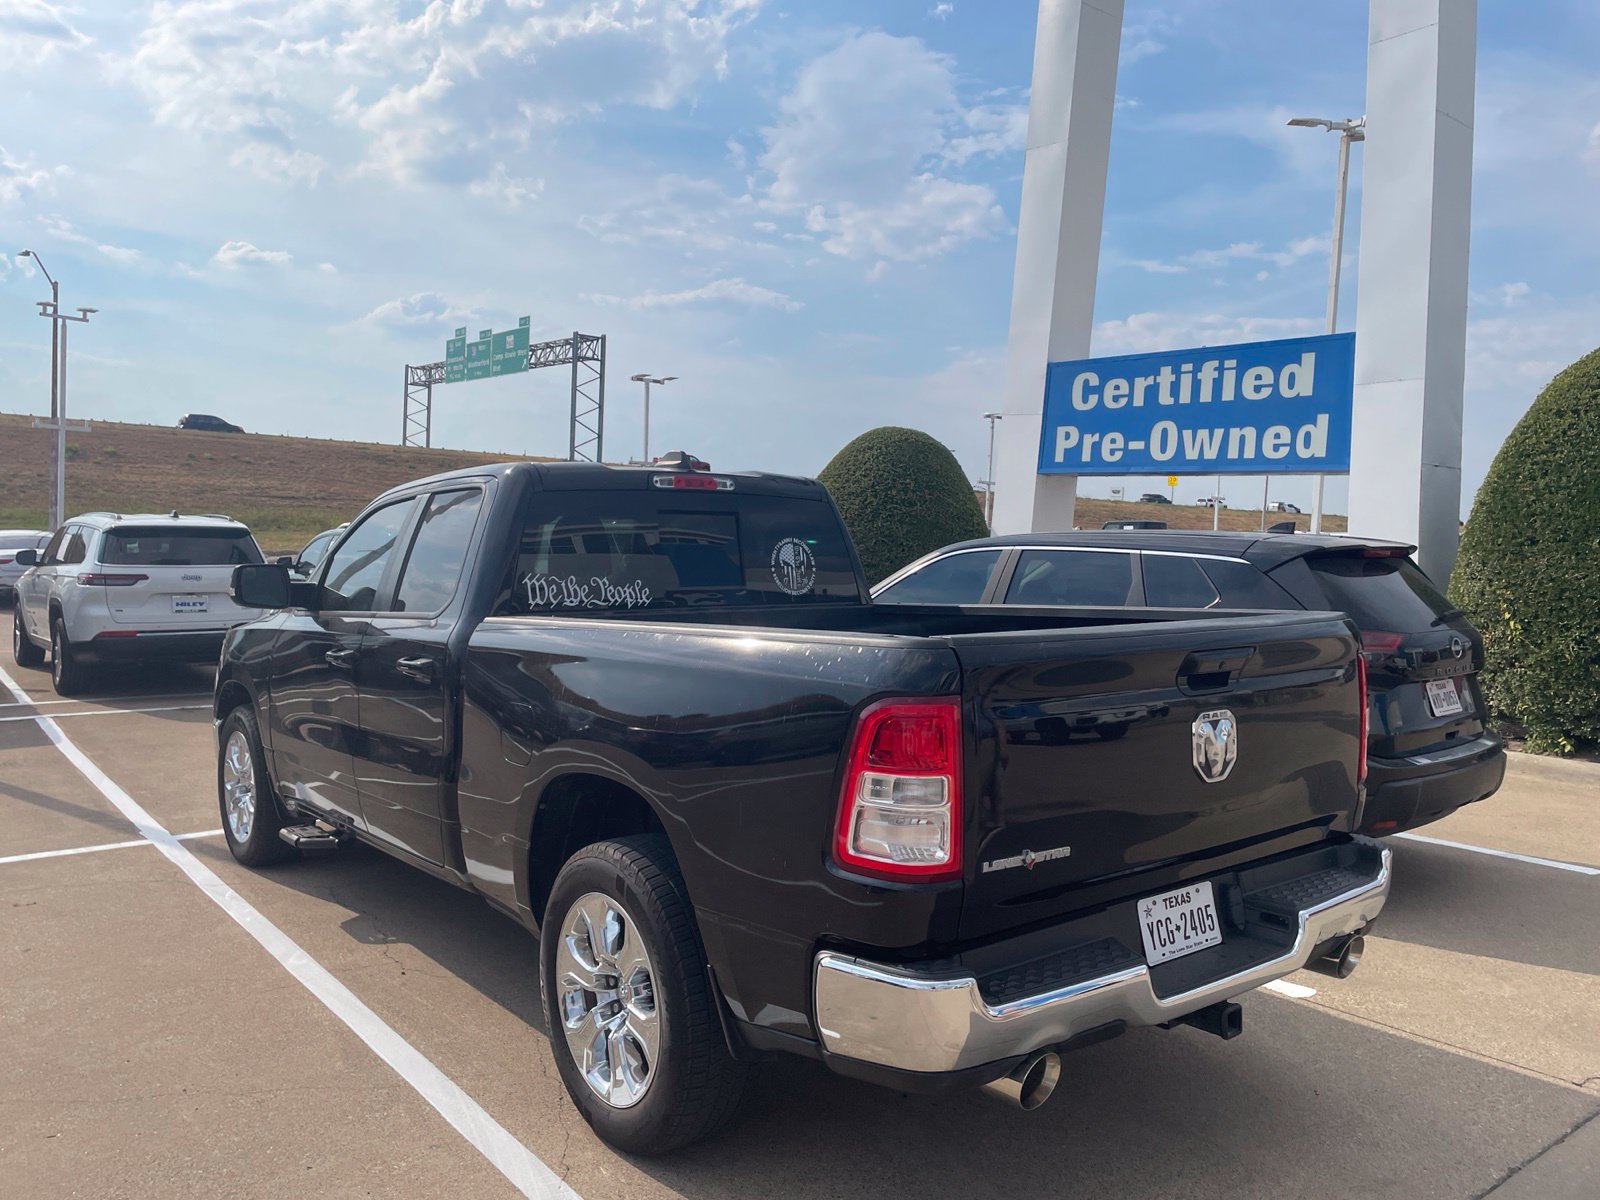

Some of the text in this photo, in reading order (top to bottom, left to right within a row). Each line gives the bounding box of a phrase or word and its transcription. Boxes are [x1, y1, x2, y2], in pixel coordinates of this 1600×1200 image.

[1071, 351, 1317, 411] Certified
[1054, 413, 1330, 464] Pre-Owned
[522, 572, 653, 609] We The People
[1435, 663, 1475, 676] ROGUE
[1202, 711, 1228, 720] RAM
[1034, 846, 1071, 863] STAR
[1162, 891, 1192, 910] TEXAS
